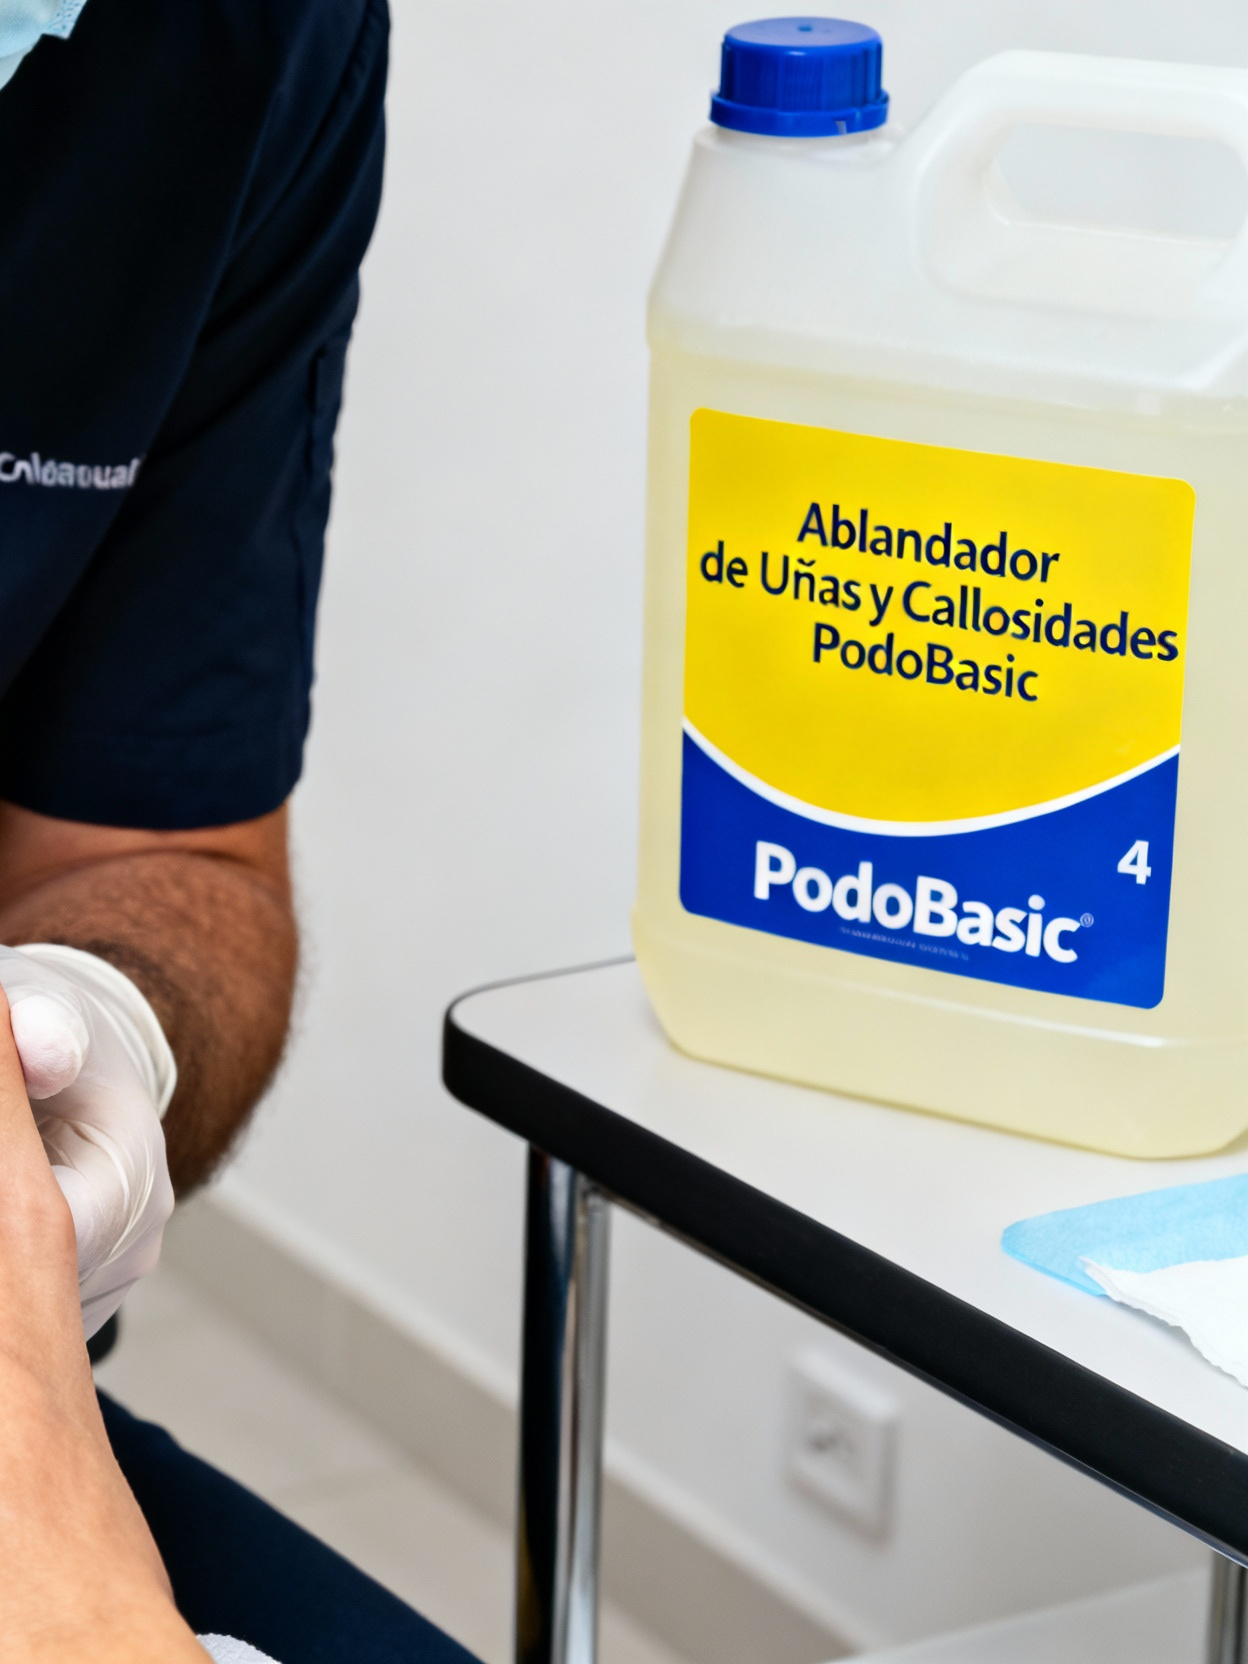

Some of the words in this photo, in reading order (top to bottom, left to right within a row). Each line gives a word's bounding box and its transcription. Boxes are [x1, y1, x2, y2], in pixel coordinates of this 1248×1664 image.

[796, 501, 1062, 584] Ablandador
[699, 540, 750, 590] de
[759, 550, 863, 612] Uñas
[868, 582, 894, 628] y
[901, 580, 1180, 663] Callosidades
[812, 622, 1039, 702] PodoBasic
[1117, 839, 1152, 885] 4
